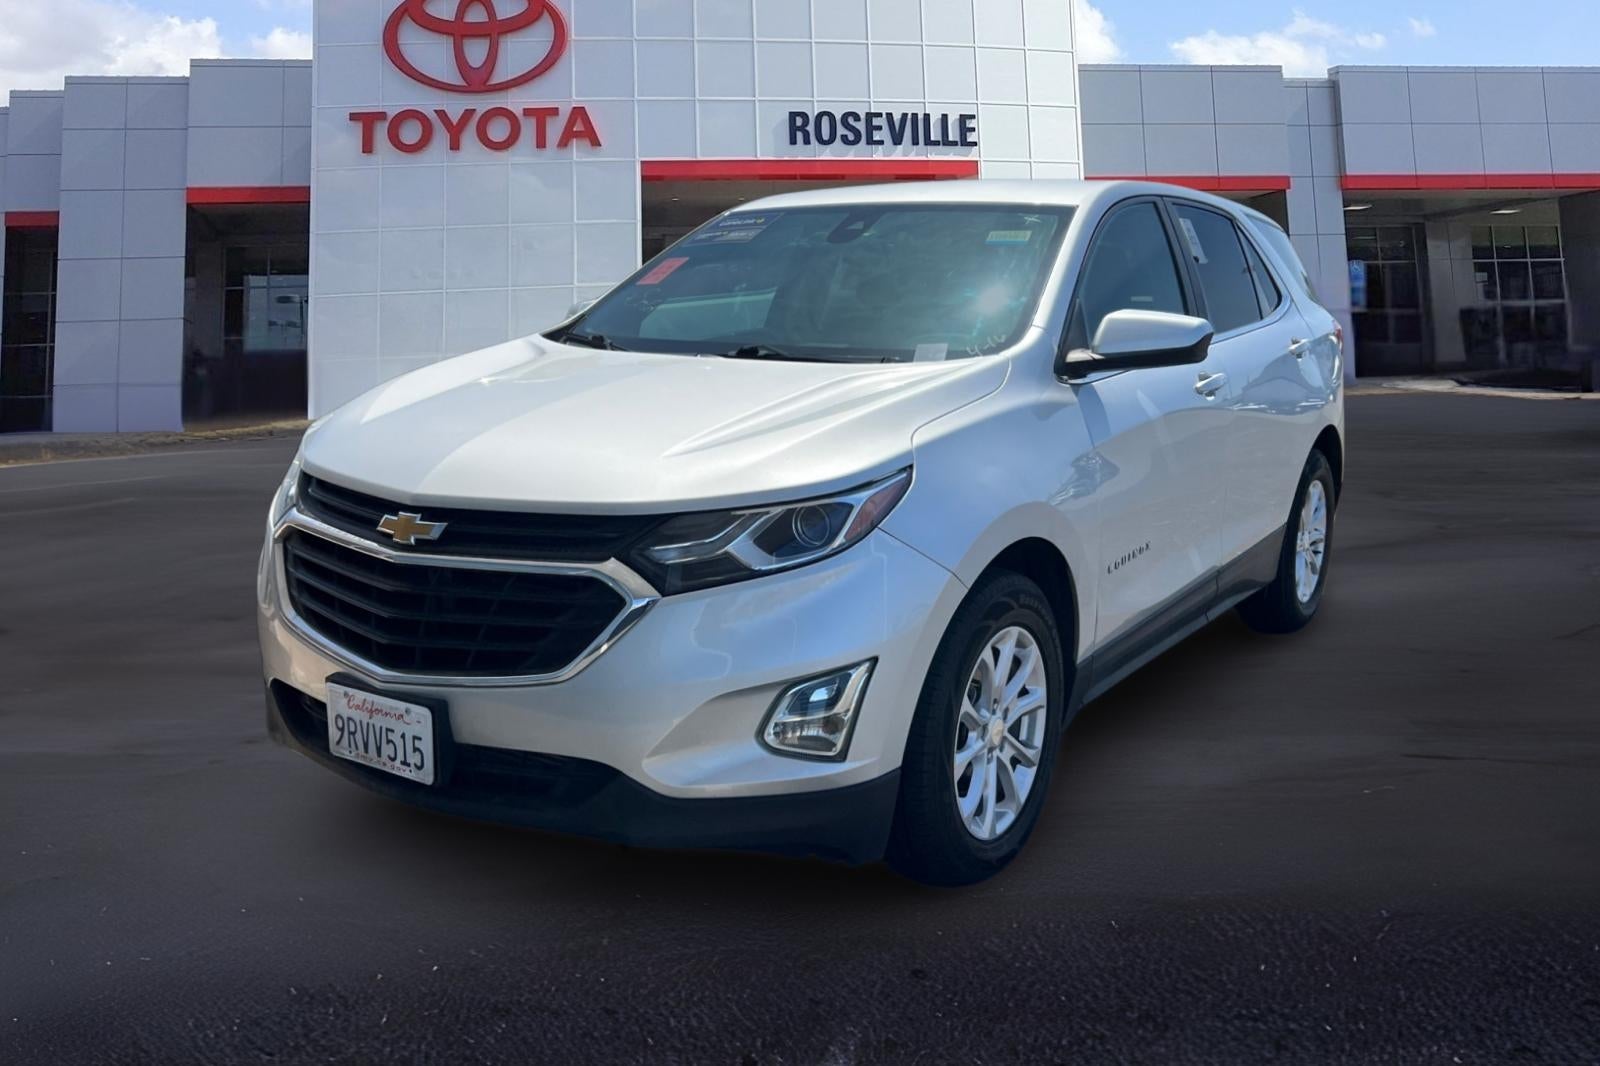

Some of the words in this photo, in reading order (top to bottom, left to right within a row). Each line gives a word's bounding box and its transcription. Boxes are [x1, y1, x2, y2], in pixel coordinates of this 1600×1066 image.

[349, 106, 602, 154] TOYOTA
[788, 111, 978, 147] ROSEVILLE
[346, 694, 411, 725] California
[334, 713, 425, 771] 9RVV515
